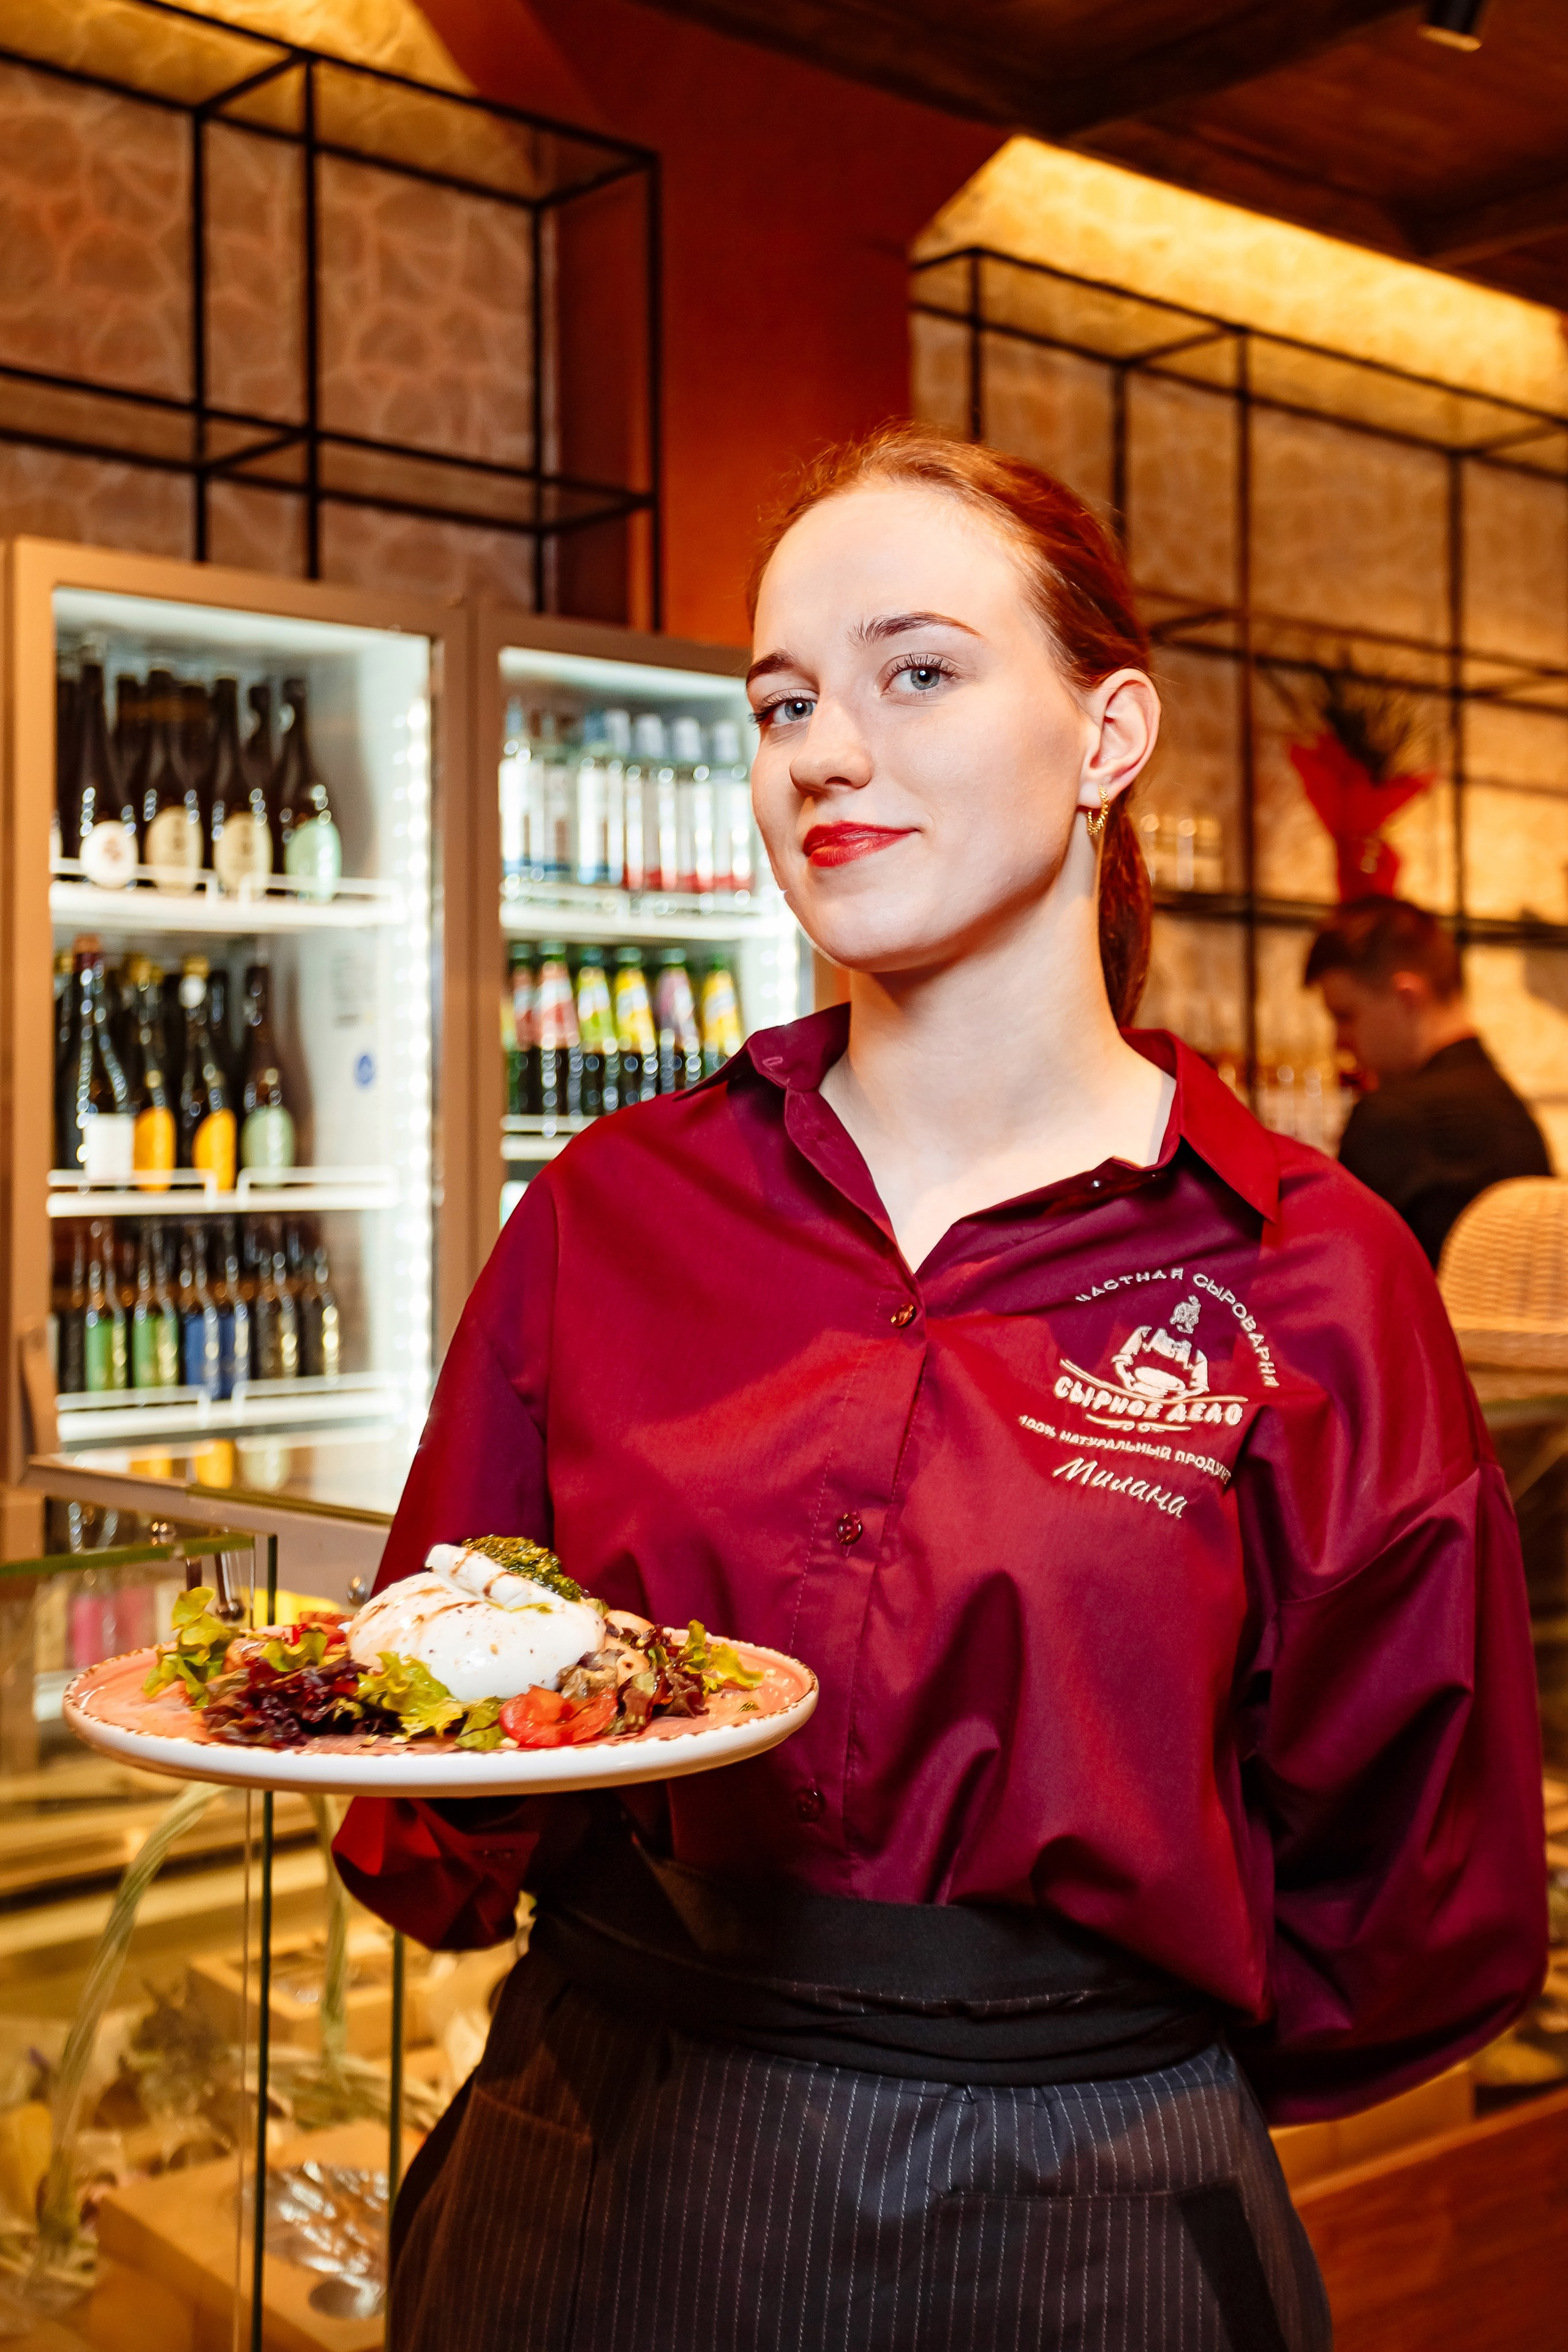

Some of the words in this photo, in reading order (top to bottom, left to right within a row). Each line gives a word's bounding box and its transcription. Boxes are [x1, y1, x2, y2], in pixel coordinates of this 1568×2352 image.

[1193, 1273, 1280, 1388] СЫРОВАРНЯ
[1054, 1375, 1164, 1419] СЫРНОЕ
[1167, 1402, 1243, 1426] ДЕЛО
[1018, 1415, 1056, 1438] 100%
[1060, 1429, 1171, 1461] НАТУРАЛЬНЫЙ
[1052, 1457, 1189, 1518] Милана
